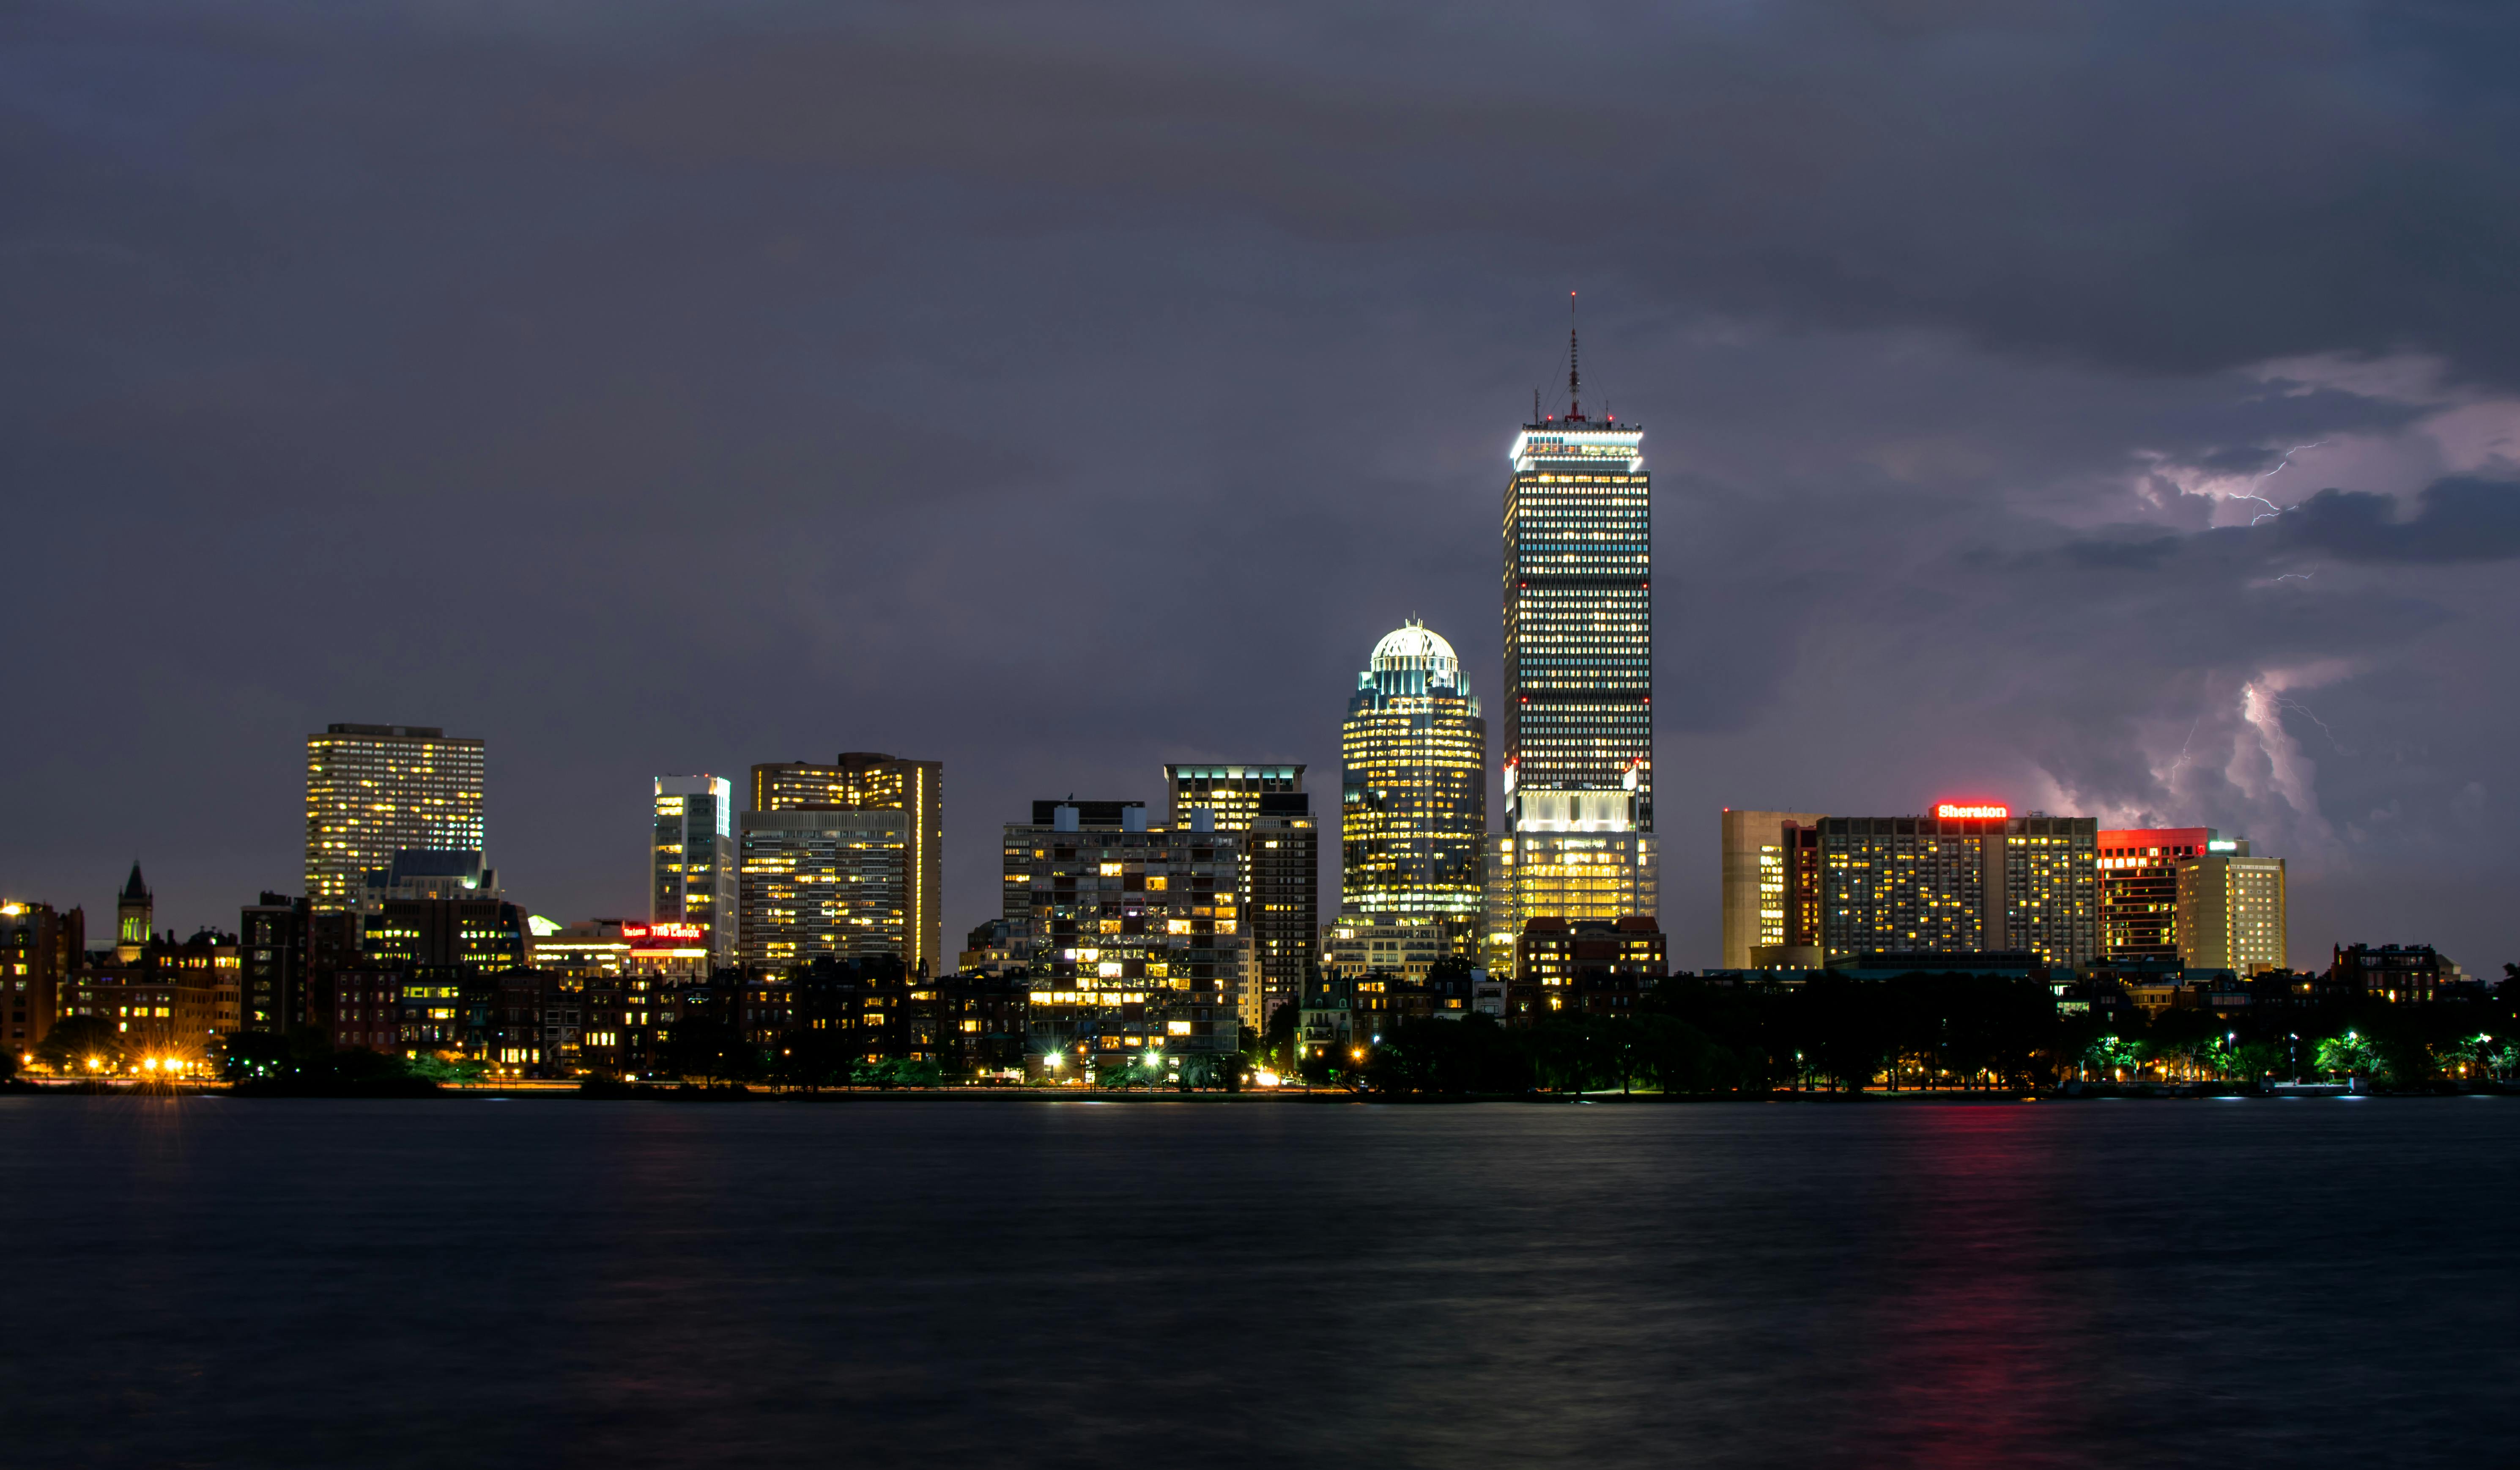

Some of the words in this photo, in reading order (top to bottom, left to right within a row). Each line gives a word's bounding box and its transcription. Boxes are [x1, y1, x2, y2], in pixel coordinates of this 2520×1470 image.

[1938, 805, 2007, 817] Sheraton
[651, 926, 669, 937] The
[671, 928, 700, 938] Lenox
